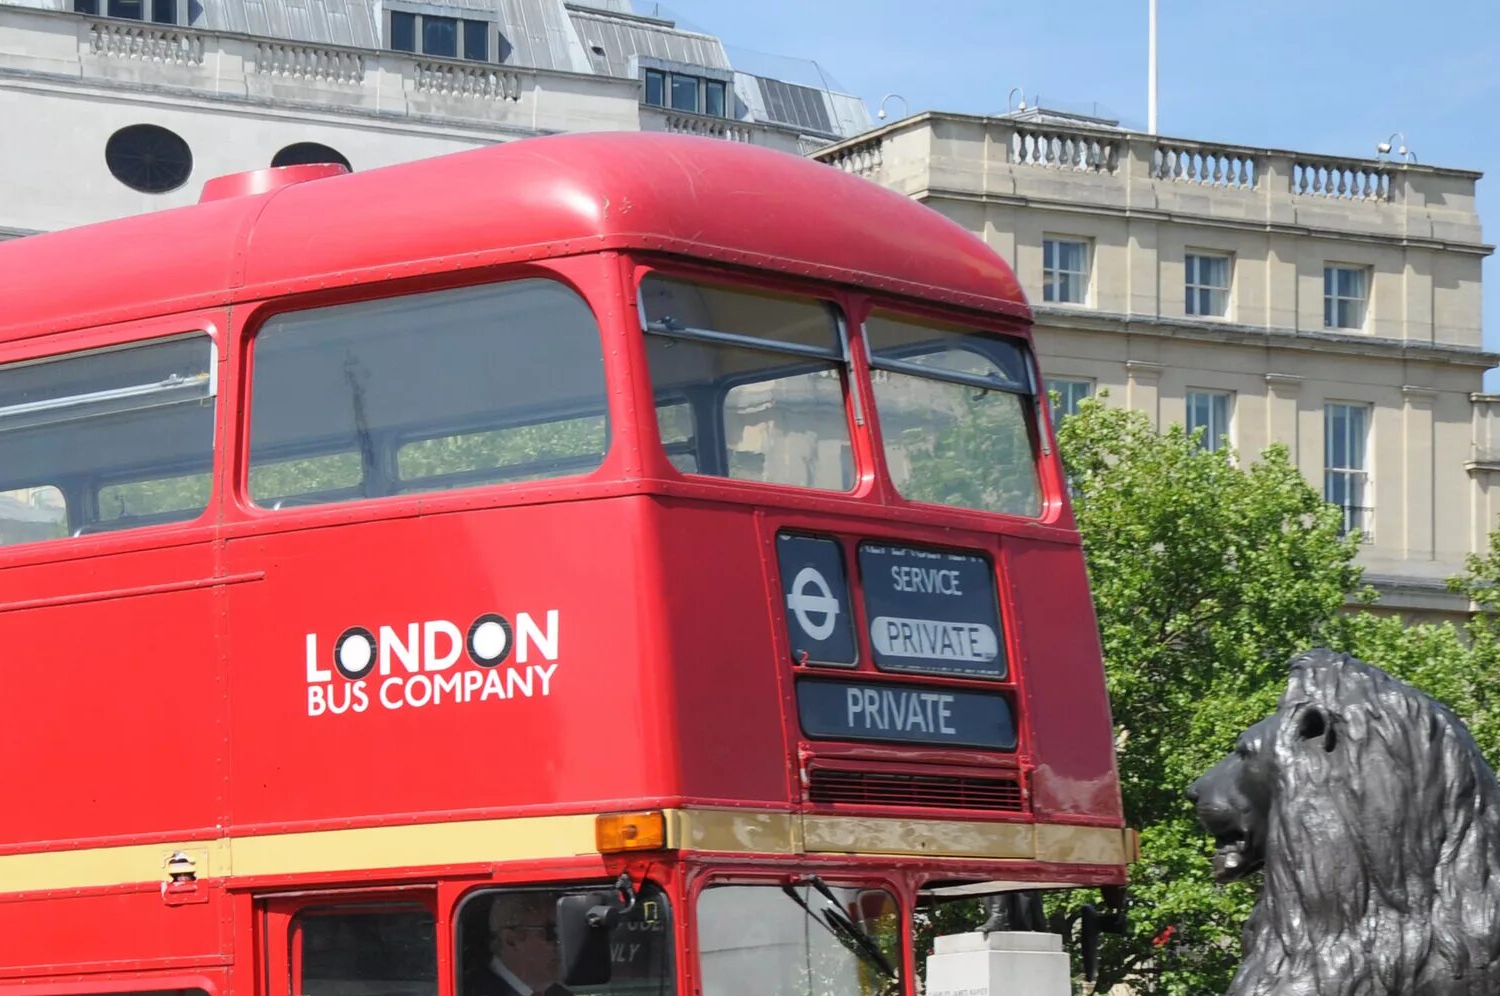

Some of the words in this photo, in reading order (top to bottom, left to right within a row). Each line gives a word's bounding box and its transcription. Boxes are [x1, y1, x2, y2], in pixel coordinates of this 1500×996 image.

[891, 565, 963, 596] SERVICE
[306, 609, 559, 683] LONDON
[887, 621, 983, 658] PRIVATE
[308, 680, 369, 717] BUS
[380, 664, 558, 710] COMPANY
[846, 688, 957, 735] PRIVATE
